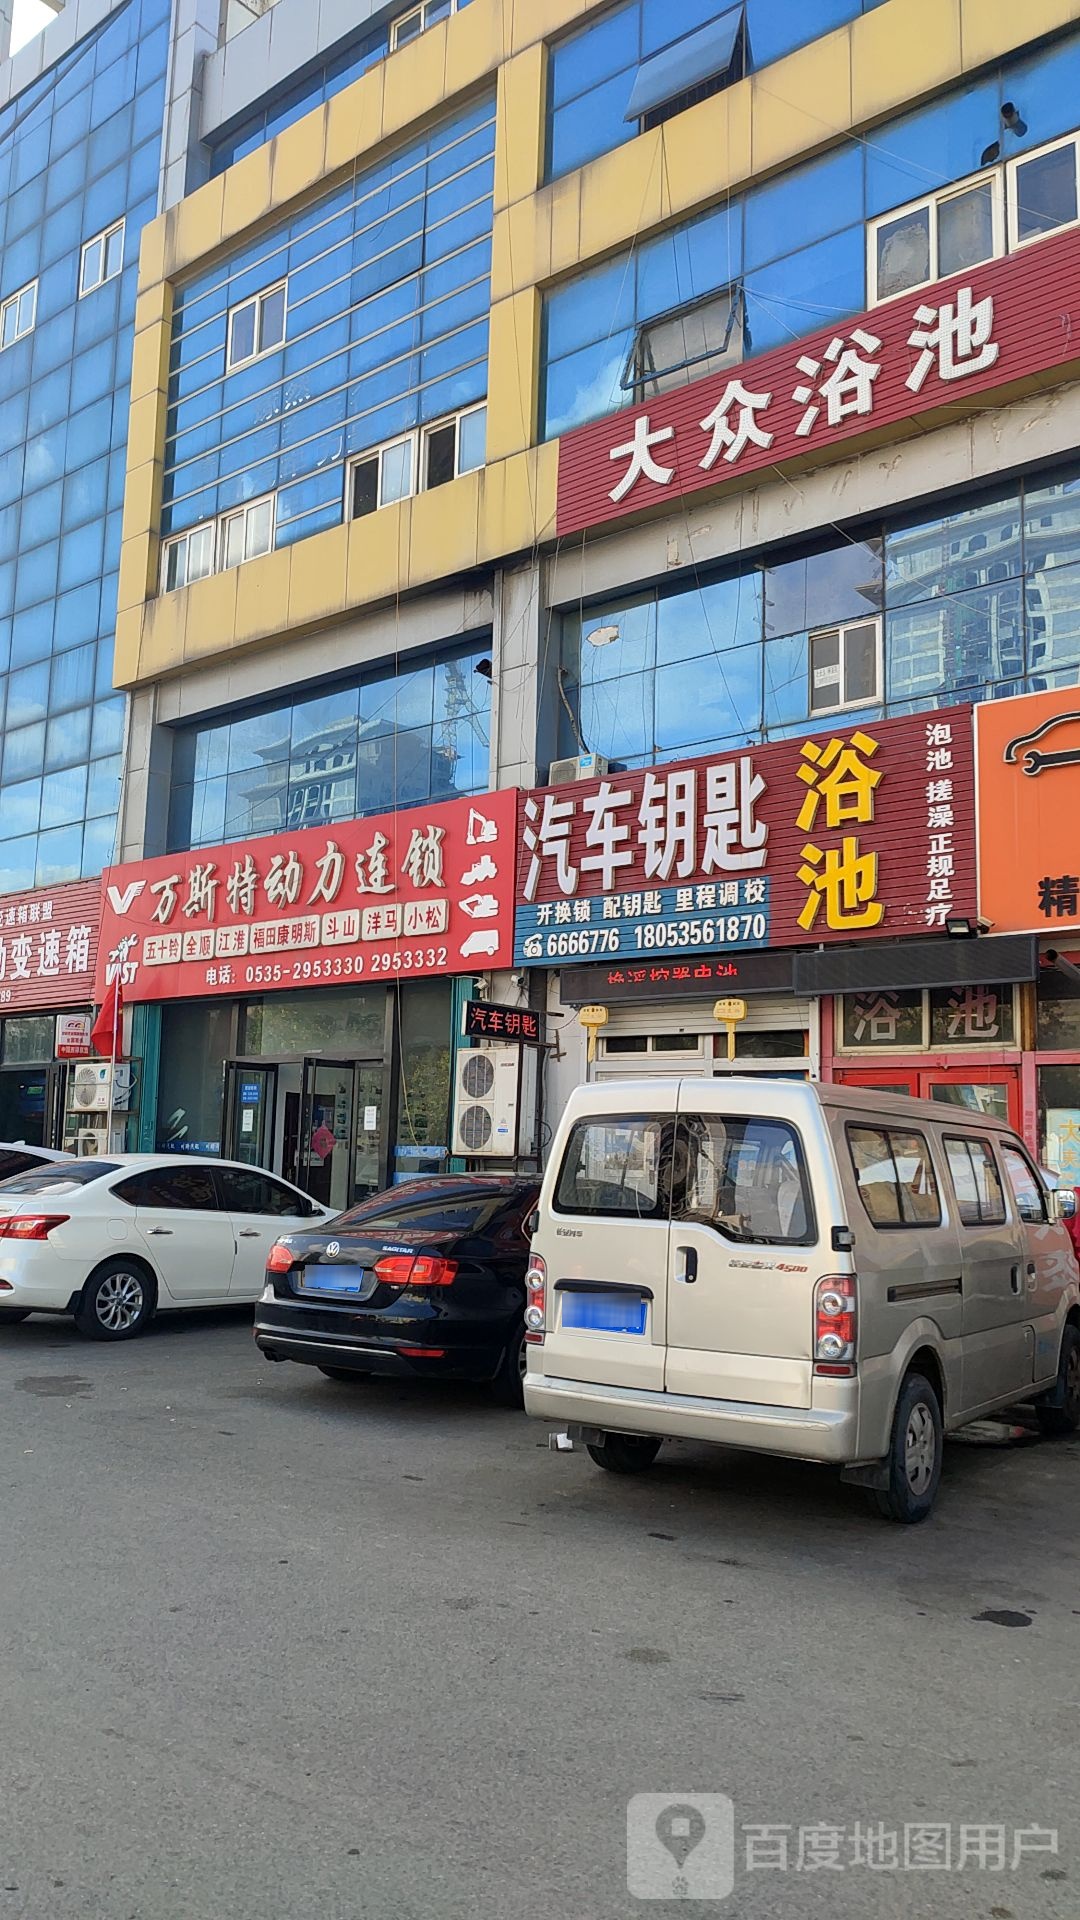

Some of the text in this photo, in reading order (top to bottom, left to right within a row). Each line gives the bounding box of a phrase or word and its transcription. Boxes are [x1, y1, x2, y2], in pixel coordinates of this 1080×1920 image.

[608, 287, 999, 503] 大众浴池
[521, 756, 769, 903] 汽车钥匙
[795, 731, 885, 931] 浴池
[925, 723, 955, 927] 泡池 搓澡 正规足疗
[150, 825, 446, 924] 万斯特动力连锁
[536, 878, 766, 926] 开换锁 配钥匙 里程调校
[1038, 875, 1079, 917] 精
[145, 906, 441, 960] 五十铃 全顺 江淮 福田康明斯 斗山 洋马 小松
[547, 913, 766, 956] 6666776 18053561870
[245, 956, 364, 983] 0535-2953330
[371, 947, 447, 972] 2953332
[470, 1007, 537, 1037] 汽车钥匙
[853, 985, 1000, 1041] 浴池
